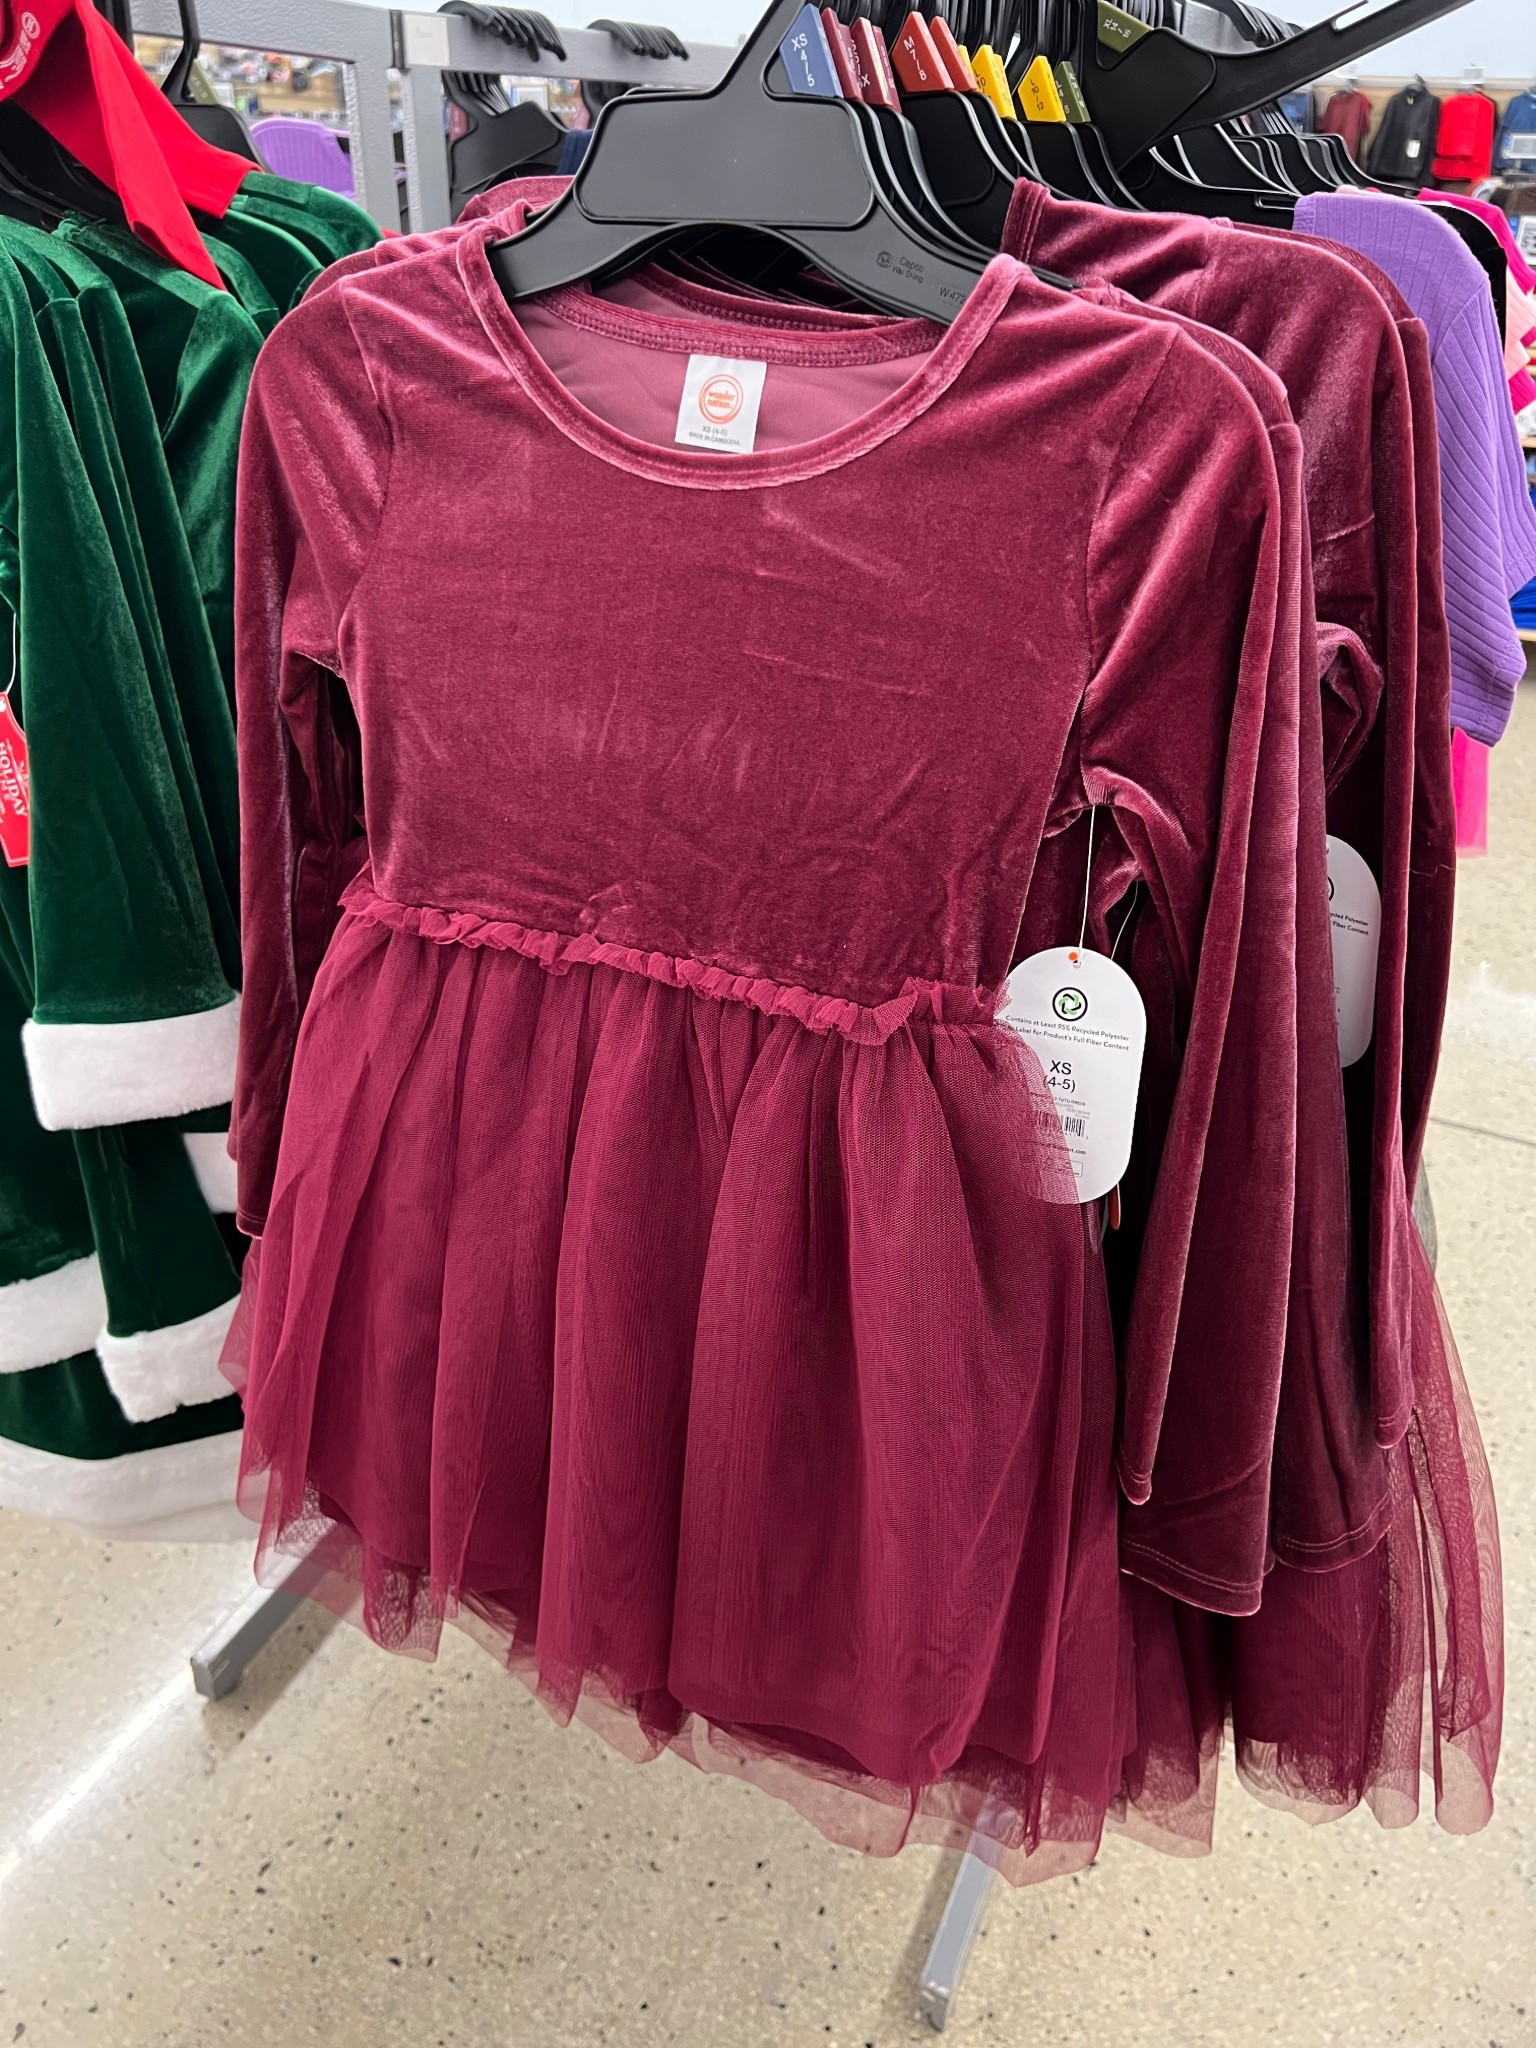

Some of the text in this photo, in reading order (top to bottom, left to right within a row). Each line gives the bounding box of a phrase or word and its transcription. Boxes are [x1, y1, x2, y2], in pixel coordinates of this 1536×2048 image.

[791, 33, 808, 52] XS
[903, 35, 915, 51] M
[702, 425, 712, 434] XS
[0, 741, 28, 816] HOLIDAY
[1332, 920, 1346, 929] Fiber
[1005, 1015, 1032, 1025] Contains
[1040, 1020, 1056, 1029] Least
[1057, 1023, 1070, 1031] 95%
[1071, 1025, 1100, 1036] Recycled
[1100, 1030, 1129, 1041] Polyester
[1015, 1026, 1032, 1034] Label
[1043, 1031, 1072, 1041] Product's
[1073, 1035, 1085, 1043] Full
[1086, 1038, 1102, 1046] Fiber
[1103, 1041, 1129, 1051] Content
[1049, 1059, 1072, 1075] XS
[1043, 1075, 1076, 1093] (4-5)
